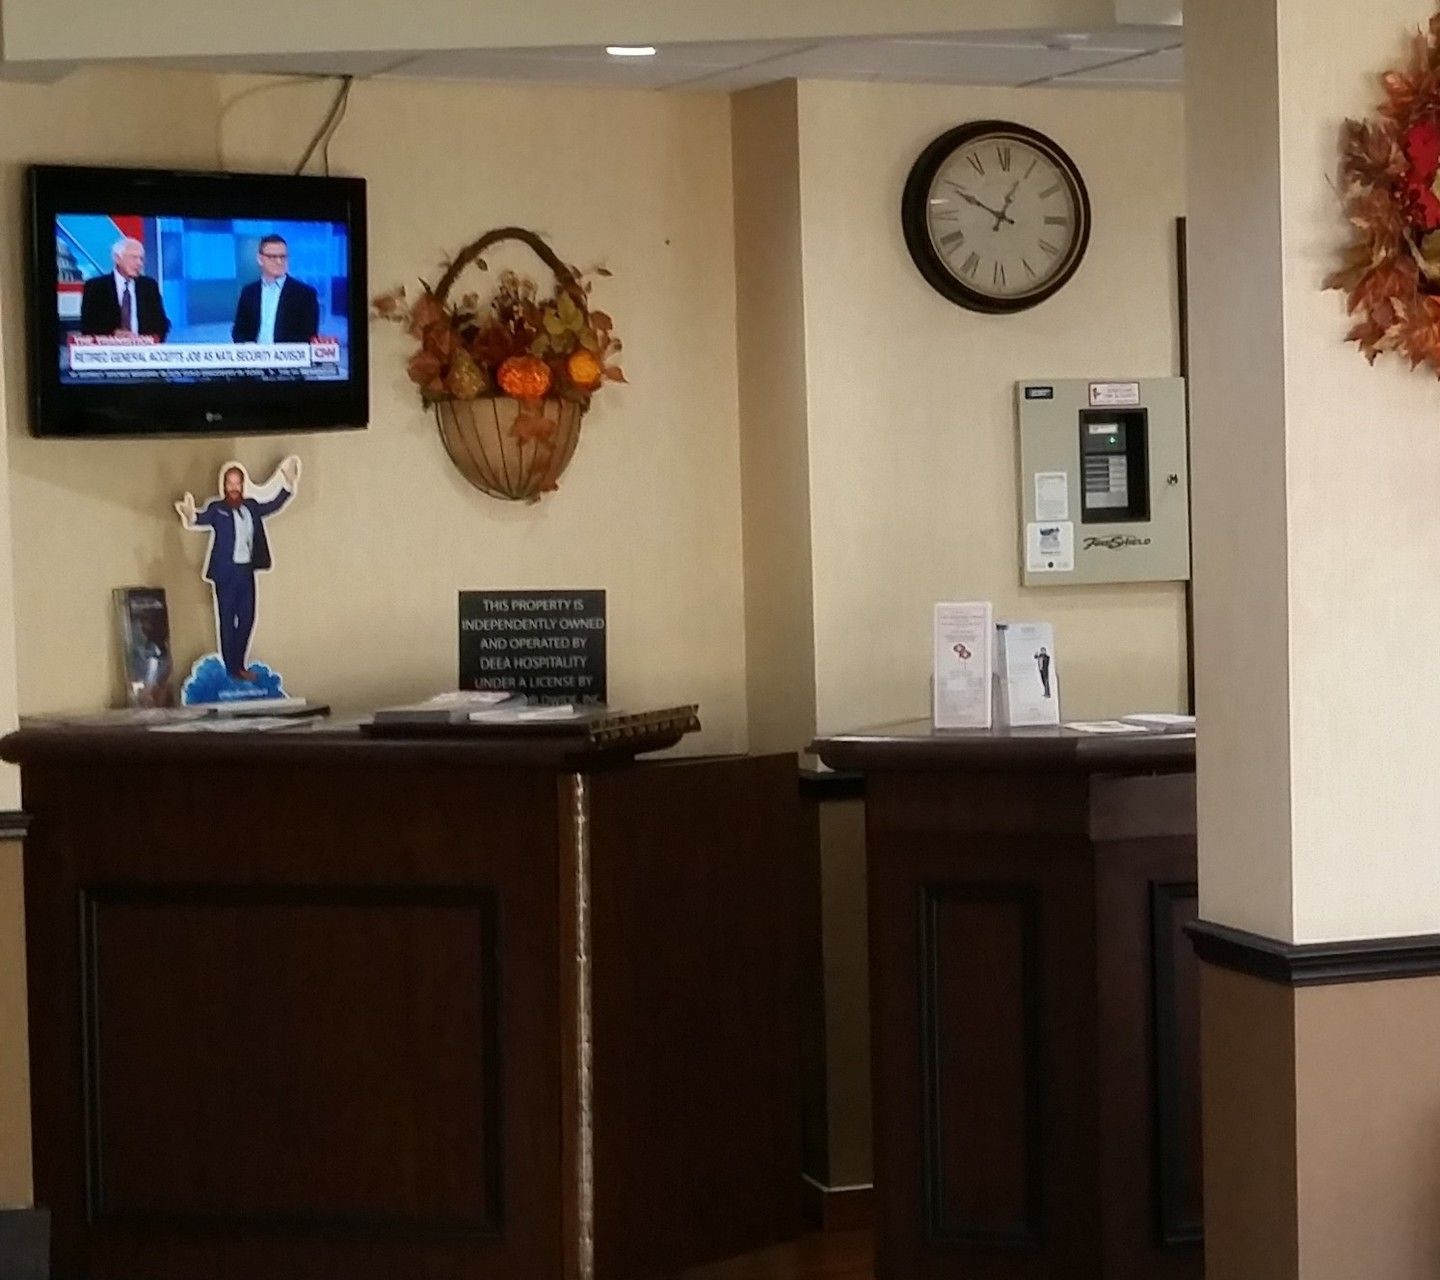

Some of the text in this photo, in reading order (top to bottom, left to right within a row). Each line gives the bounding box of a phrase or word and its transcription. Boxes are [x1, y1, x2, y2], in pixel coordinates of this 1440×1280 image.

[314, 348, 336, 359] CNN
[483, 598, 584, 612] THIS PROPERTY IS
[462, 618, 604, 631] INDEPENDENTLY OWNED
[480, 637, 587, 650] AND OPERATED BY
[514, 655, 587, 669] HOSPITALITY
[474, 675, 593, 689] UNDER A LICENSE BY
